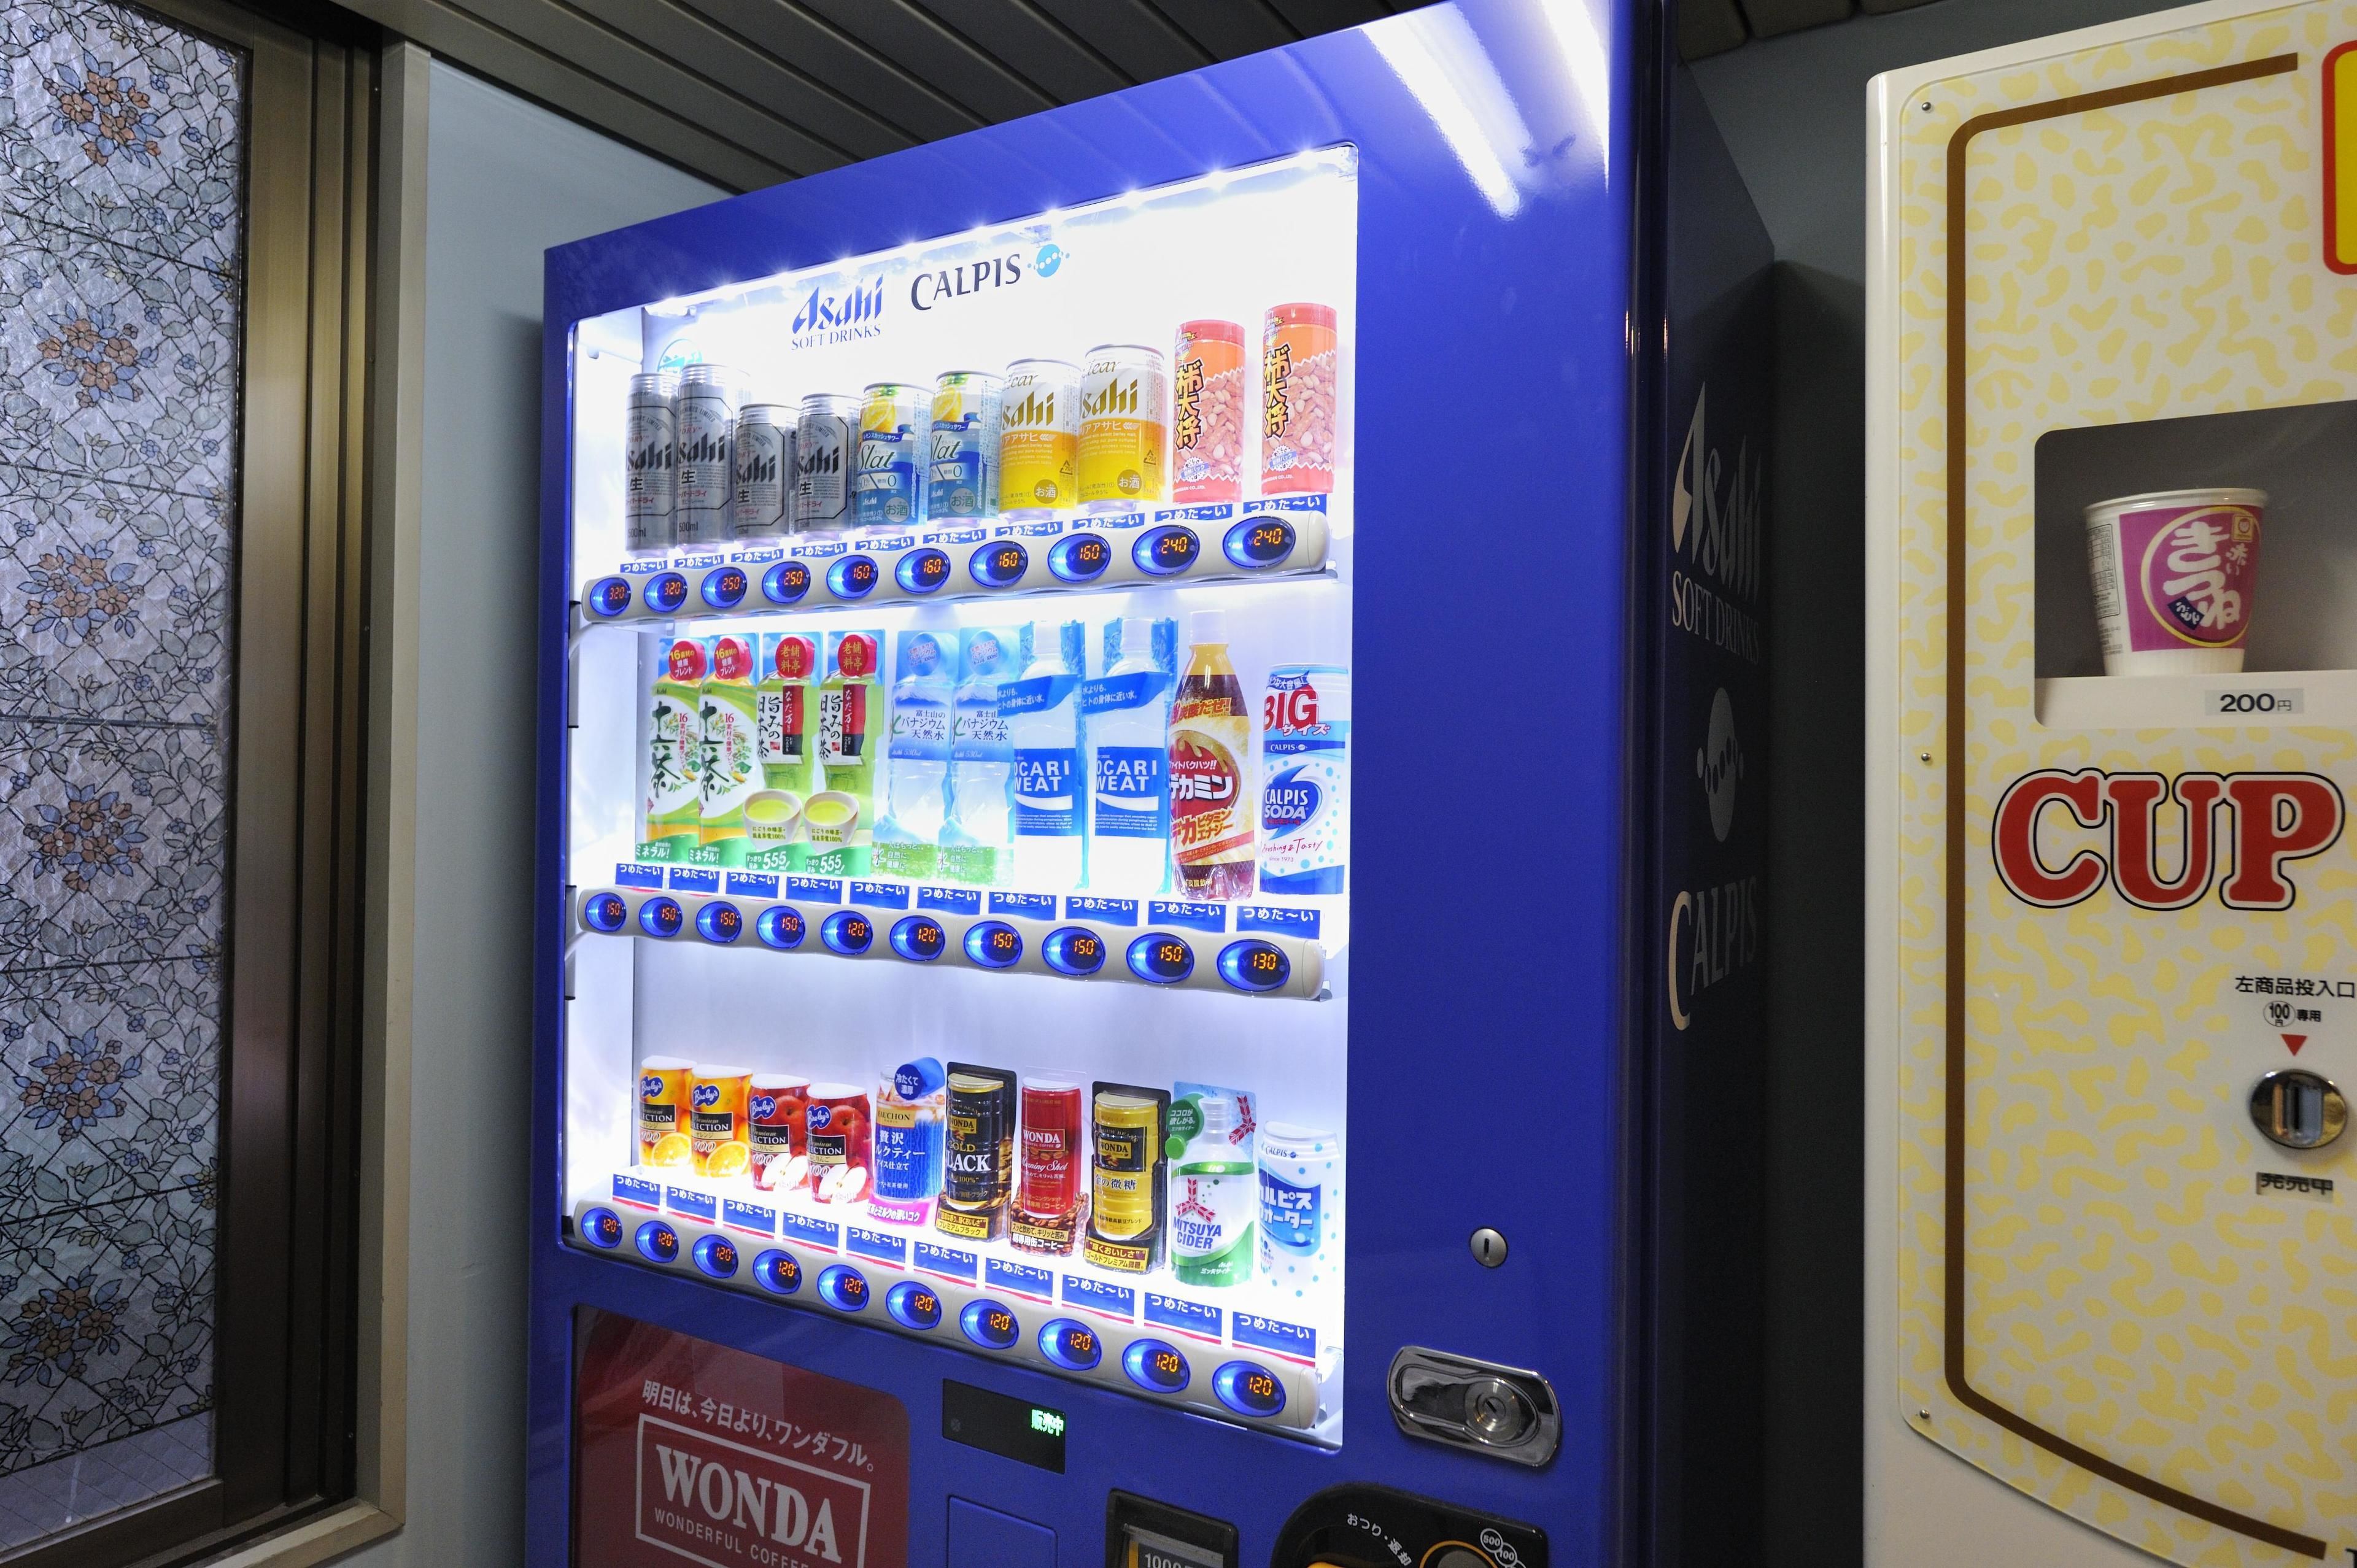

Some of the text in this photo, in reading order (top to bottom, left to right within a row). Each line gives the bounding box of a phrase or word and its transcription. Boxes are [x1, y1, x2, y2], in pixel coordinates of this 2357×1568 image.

[911, 253, 1021, 311] CALPIS
[792, 274, 883, 334] Asahi
[791, 324, 881, 350] SOFT DRINKS
[1082, 378, 1138, 419] sahi
[678, 433, 725, 464] sahi
[630, 477, 643, 490] 生
[681, 469, 695, 484] 生
[1673, 380, 1761, 606] Asahi
[951, 496, 973, 507] お酒
[886, 504, 908, 516] お酒
[629, 528, 646, 538] 500ml
[679, 522, 698, 531] 500ml
[1254, 528, 1281, 545] 240
[1080, 545, 1099, 560] 160
[1161, 537, 1186, 554] 240
[924, 559, 940, 573] 160
[1000, 552, 1018, 567] 160
[2226, 543, 2248, 576] 赤い
[784, 571, 803, 585] 250
[854, 565, 869, 579] 160
[2163, 521, 2242, 629] きつね
[665, 582, 681, 595] 320
[722, 577, 740, 590] 250
[610, 587, 624, 600] 320
[1672, 571, 1759, 665] SOFT DRINKS
[781, 646, 800, 657] 老舗
[843, 643, 861, 654] 老舗
[721, 666, 736, 676] ブレンド
[781, 660, 800, 673] 料亭
[844, 657, 862, 670] 料亭
[675, 667, 692, 677] ブレンド
[1264, 685, 1318, 732] BIG
[2220, 693, 2292, 713] 200円
[768, 697, 783, 740] 旨みの
[830, 695, 843, 740] 旨みの
[902, 718, 945, 729] バナジウム
[962, 718, 1008, 730] バナジウム
[758, 697, 769, 759] 日本茶
[820, 695, 830, 759] 日本茶
[1282, 724, 1330, 736] サイズ
[912, 730, 944, 740] 天然水
[972, 731, 1007, 741] 天然水
[1170, 774, 1233, 800] デカミン
[1266, 789, 1309, 805] CALPIS
[1197, 809, 1233, 825] ビタミン
[1264, 805, 1306, 819] SODA
[1198, 824, 1233, 841] エナジー
[1992, 768, 2345, 911] CUP
[1293, 838, 1323, 854] Tasty
[608, 903, 620, 915] 150
[662, 908, 675, 920] 150
[721, 913, 735, 925] 150
[783, 917, 797, 930] 150
[848, 923, 864, 936] 120
[918, 929, 935, 942] 120
[994, 933, 1012, 948] 150
[1074, 940, 1094, 955] 150
[1160, 946, 1182, 962] 150
[1668, 875, 1757, 1031] CALPIS
[1253, 954, 1276, 970] 130
[2235, 976, 2355, 998] 左商品投入口
[2297, 1010, 2321, 1022] 専用
[896, 1074, 918, 1086] 冷たくて
[902, 1086, 913, 1095] 濃厚
[641, 1132, 660, 1141] 100
[880, 1132, 904, 1145] 贅沢
[1023, 1129, 1061, 1143] WONDA
[694, 1141, 716, 1152] 100
[876, 1144, 925, 1159] ルクティー
[1266, 1146, 1287, 1157] CALPIS
[1047, 1162, 1068, 1172] Shot
[1096, 1175, 1136, 1190] 金の微糖
[603, 1219, 616, 1232] 120
[939, 1221, 980, 1235] プレミアムブラック
[1174, 1217, 1221, 1236] MITSUYA
[658, 1232, 671, 1246] 120
[1013, 1234, 1063, 1249] 朝専用缶コーヒー
[1177, 1234, 1213, 1249] CIDER
[717, 1246, 731, 1261] 120
[1086, 1251, 1140, 1269] ゴールドプレミアム微糖
[779, 1262, 794, 1276] 120
[845, 1278, 861, 1294] 120
[915, 1296, 932, 1311] 120
[990, 1313, 1009, 1330] 120
[1070, 1333, 1090, 1351] 120
[1156, 1354, 1177, 1372] 120
[1250, 1376, 1271, 1396] 120
[642, 1379, 873, 1472] 明日は、今日より、ワンダフル。
[1032, 1409, 1063, 1436] 販売中
[656, 1444, 841, 1564] WONDA
[655, 1508, 741, 1553] WONDERFUL
[1347, 1513, 1411, 1566] おつり・返却
[1483, 1535, 1501, 1546] 500
[1500, 1549, 1514, 1559] 100
